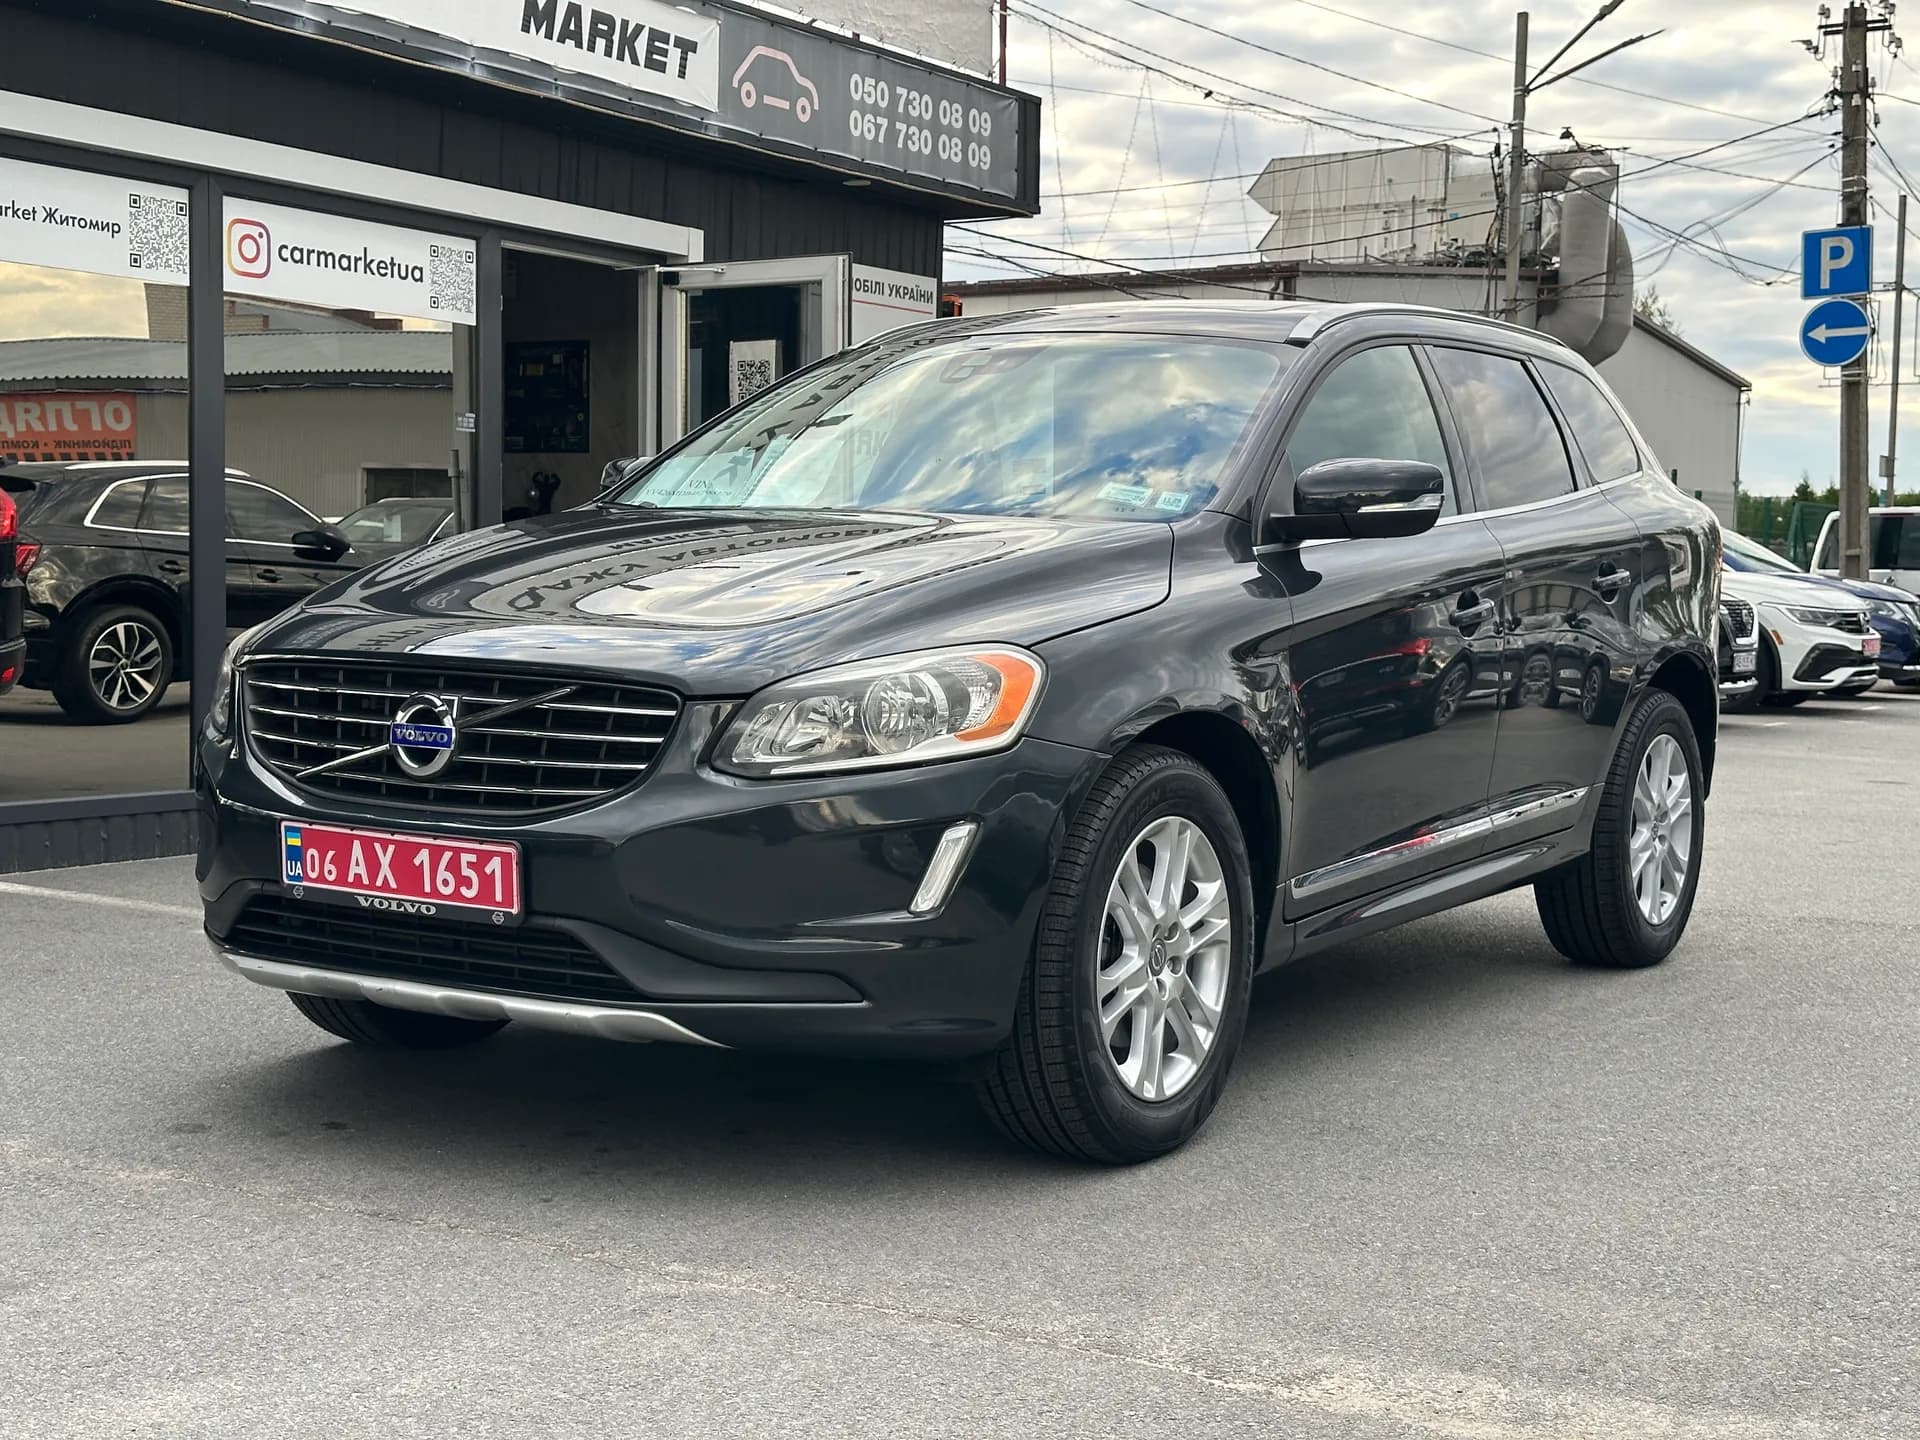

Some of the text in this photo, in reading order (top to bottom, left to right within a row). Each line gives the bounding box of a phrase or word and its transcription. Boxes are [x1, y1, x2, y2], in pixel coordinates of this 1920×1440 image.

[521, 0, 698, 79] MARKET
[850, 73, 992, 137] 050 730 08 09
[849, 110, 991, 170] 067 730 08 09
[42, 206, 121, 239] Житомир
[278, 243, 424, 283] carmarketua
[1820, 236, 1854, 289] P
[852, 278, 934, 304] ОБІЛІ УКРАЇНИ
[394, 728, 448, 743] VOLVO
[287, 860, 303, 877] UA
[306, 839, 503, 903] 06 AX 1651
[354, 895, 437, 916] VOLVO
